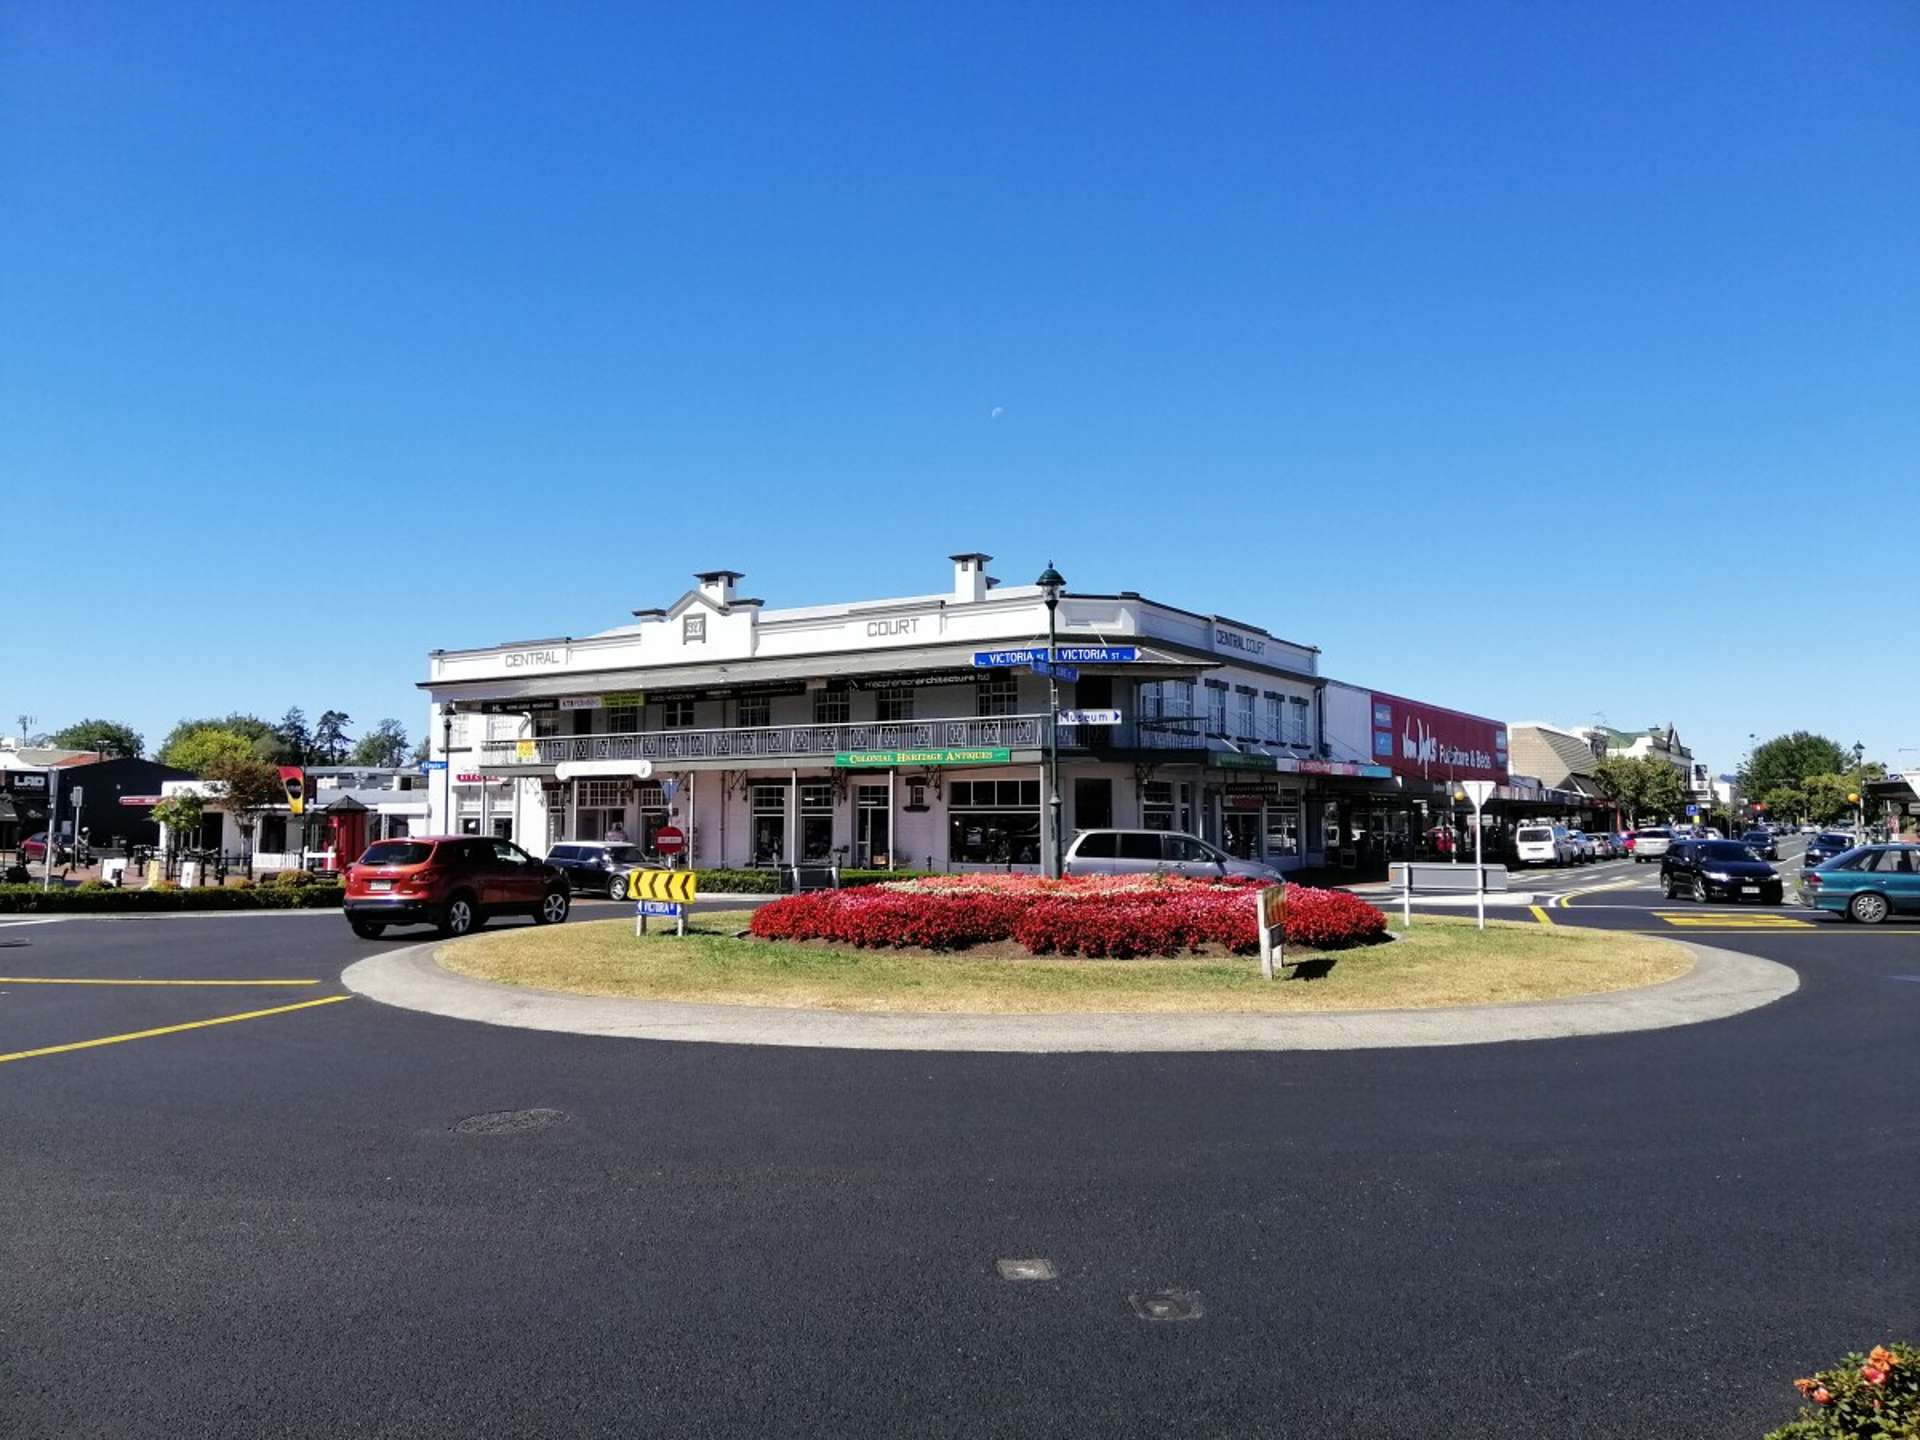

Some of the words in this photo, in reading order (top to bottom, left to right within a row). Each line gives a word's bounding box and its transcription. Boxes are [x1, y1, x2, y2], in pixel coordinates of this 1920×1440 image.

[867, 618, 920, 637] COURT
[1216, 630, 1245, 650] CENTRAL
[1246, 638, 1266, 655] COURT
[505, 650, 559, 668] CENTRAL
[989, 651, 1034, 664] VICTORIA
[1061, 649, 1108, 660] VICTORIA
[1111, 652, 1120, 660] ST
[1060, 711, 1108, 722] Museum
[1476, 750, 1492, 769] Beds
